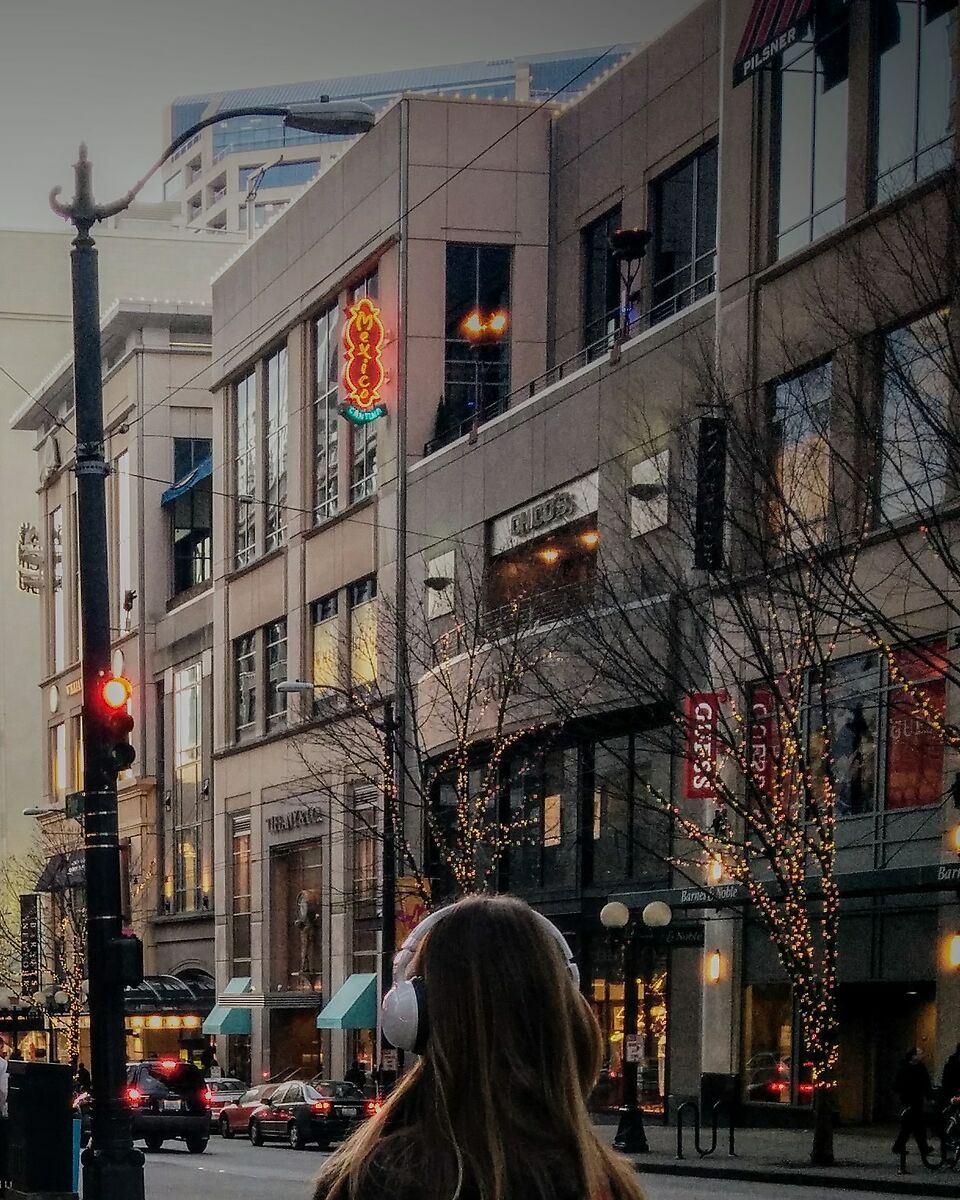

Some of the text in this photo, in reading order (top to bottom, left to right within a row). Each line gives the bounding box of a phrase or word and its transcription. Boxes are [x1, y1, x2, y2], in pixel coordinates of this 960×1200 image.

[743, 27, 796, 76] PILSNER
[355, 311, 373, 399] Mexico
[693, 702, 713, 789] GUESS
[681, 889, 706, 902] Barnes
[716, 885, 738, 899] Noble
